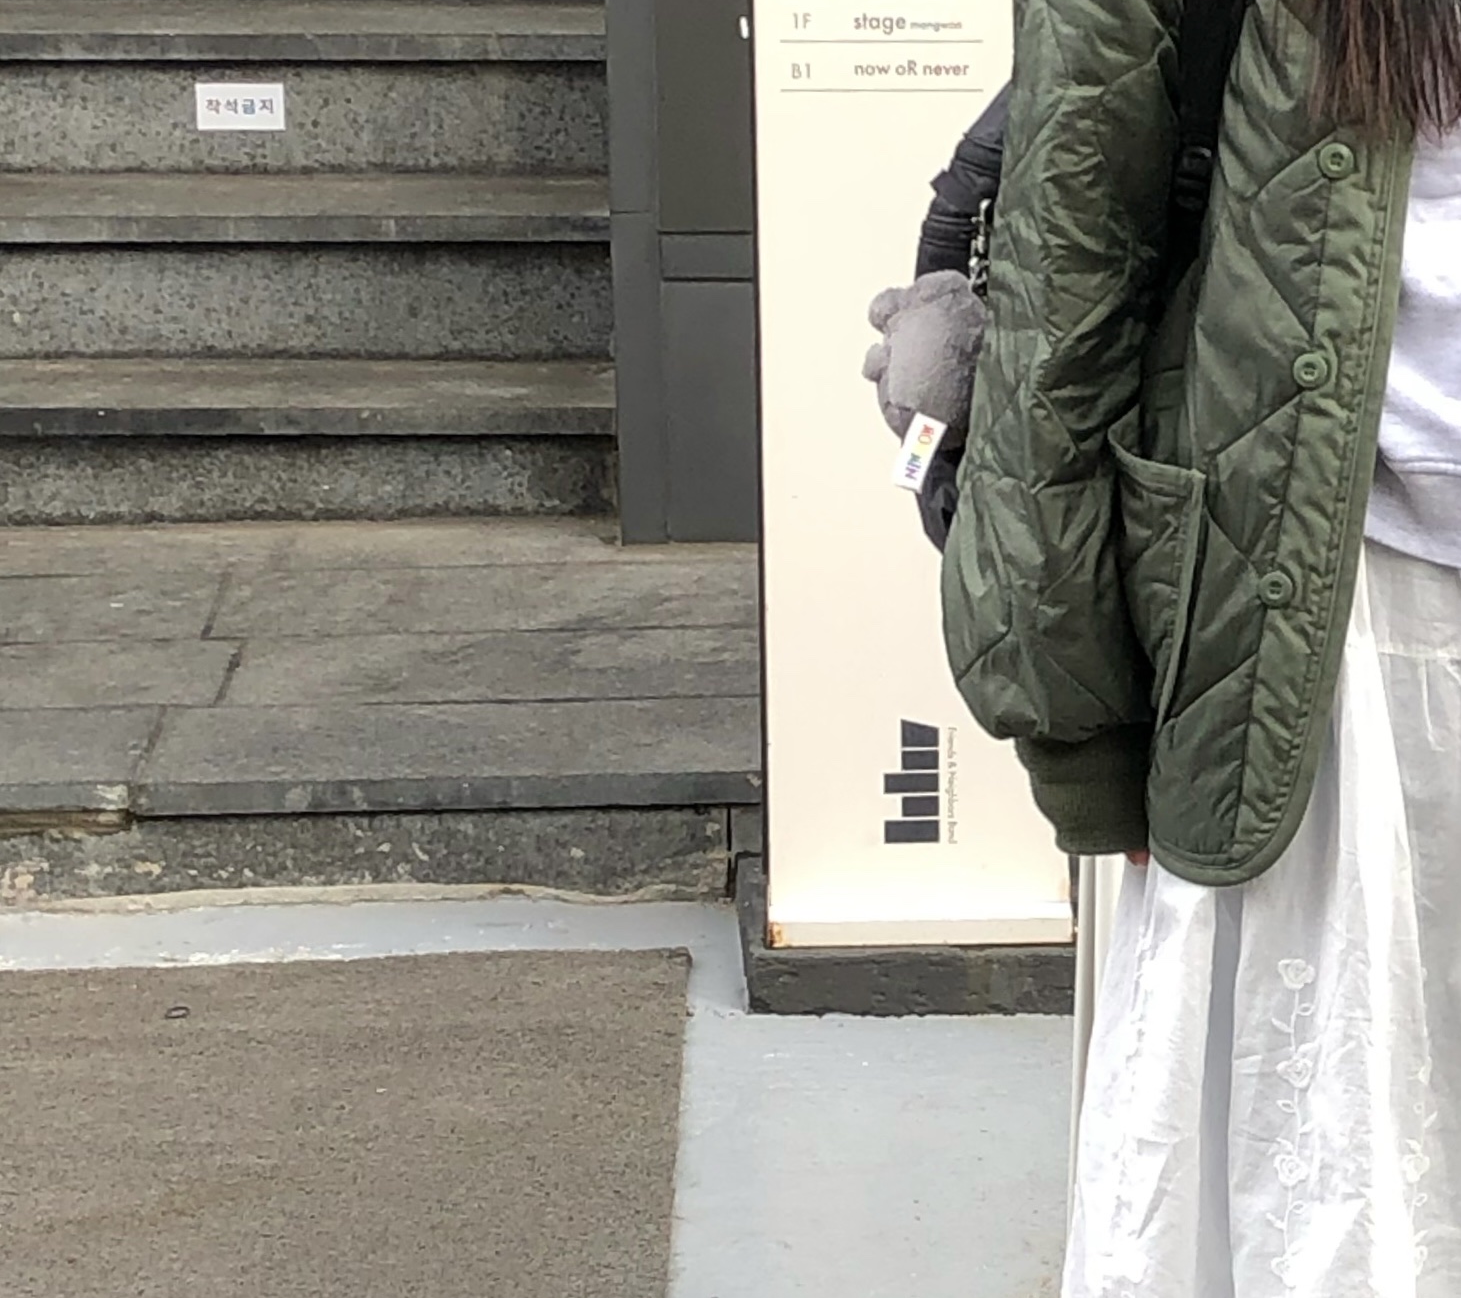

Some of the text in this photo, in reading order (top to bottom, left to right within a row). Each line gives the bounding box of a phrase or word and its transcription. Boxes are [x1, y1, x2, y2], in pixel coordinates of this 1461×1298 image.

[792, 12, 812, 30] 1F
[853, 13, 906, 35] stage
[791, 60, 969, 79] B1 now oR never
[205, 98, 274, 115] 착석금지
